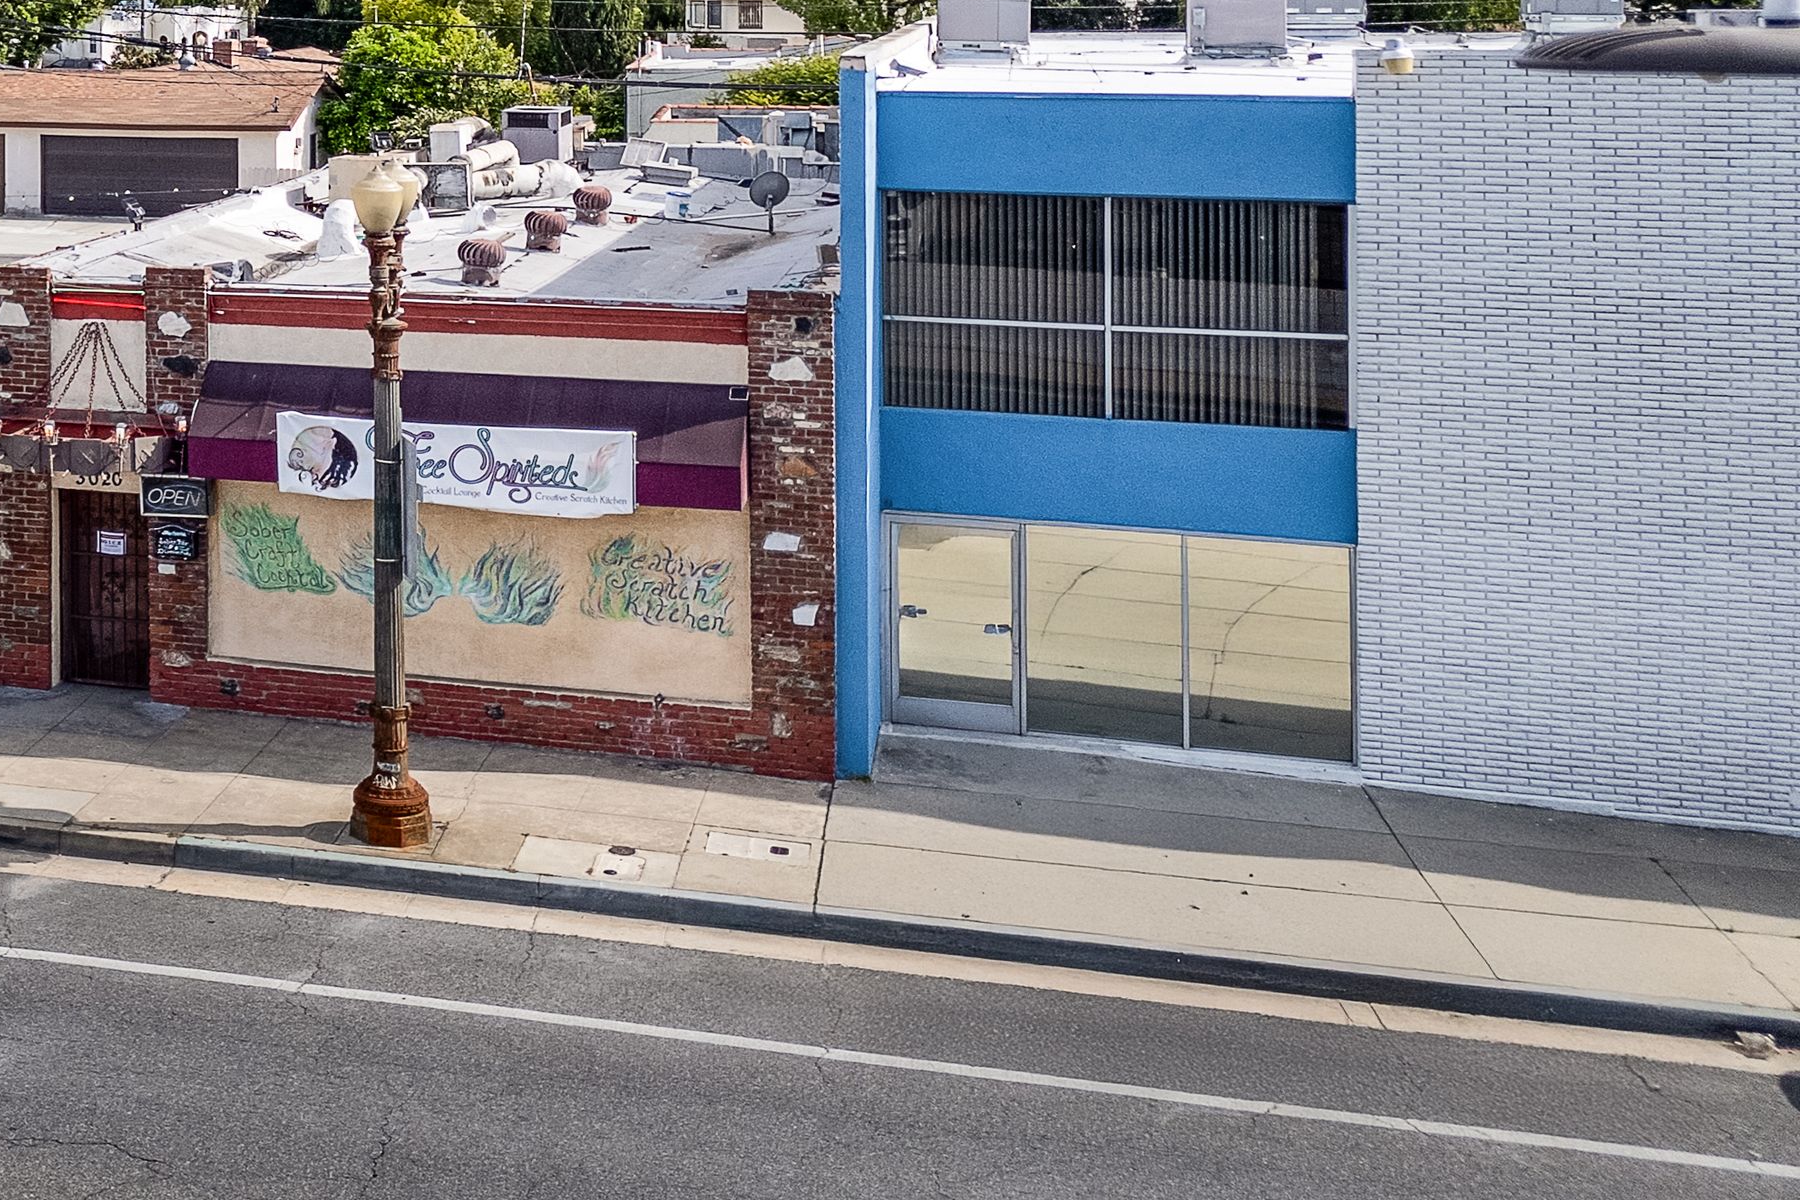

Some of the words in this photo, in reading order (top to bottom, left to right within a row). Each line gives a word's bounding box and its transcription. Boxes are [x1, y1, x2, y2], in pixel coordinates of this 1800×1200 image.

[147, 487, 201, 507] OPEN
[423, 485, 452, 495] Cocktail
[453, 487, 481, 498] Lounge
[534, 491, 568, 502] Creative
[569, 493, 598, 504] Scratch
[599, 495, 628, 505] Kitchen
[228, 509, 292, 539] Sober
[244, 538, 300, 568] Craft
[601, 538, 721, 579] Creative
[610, 569, 712, 606] Scratch
[624, 591, 728, 634] Kitchen
